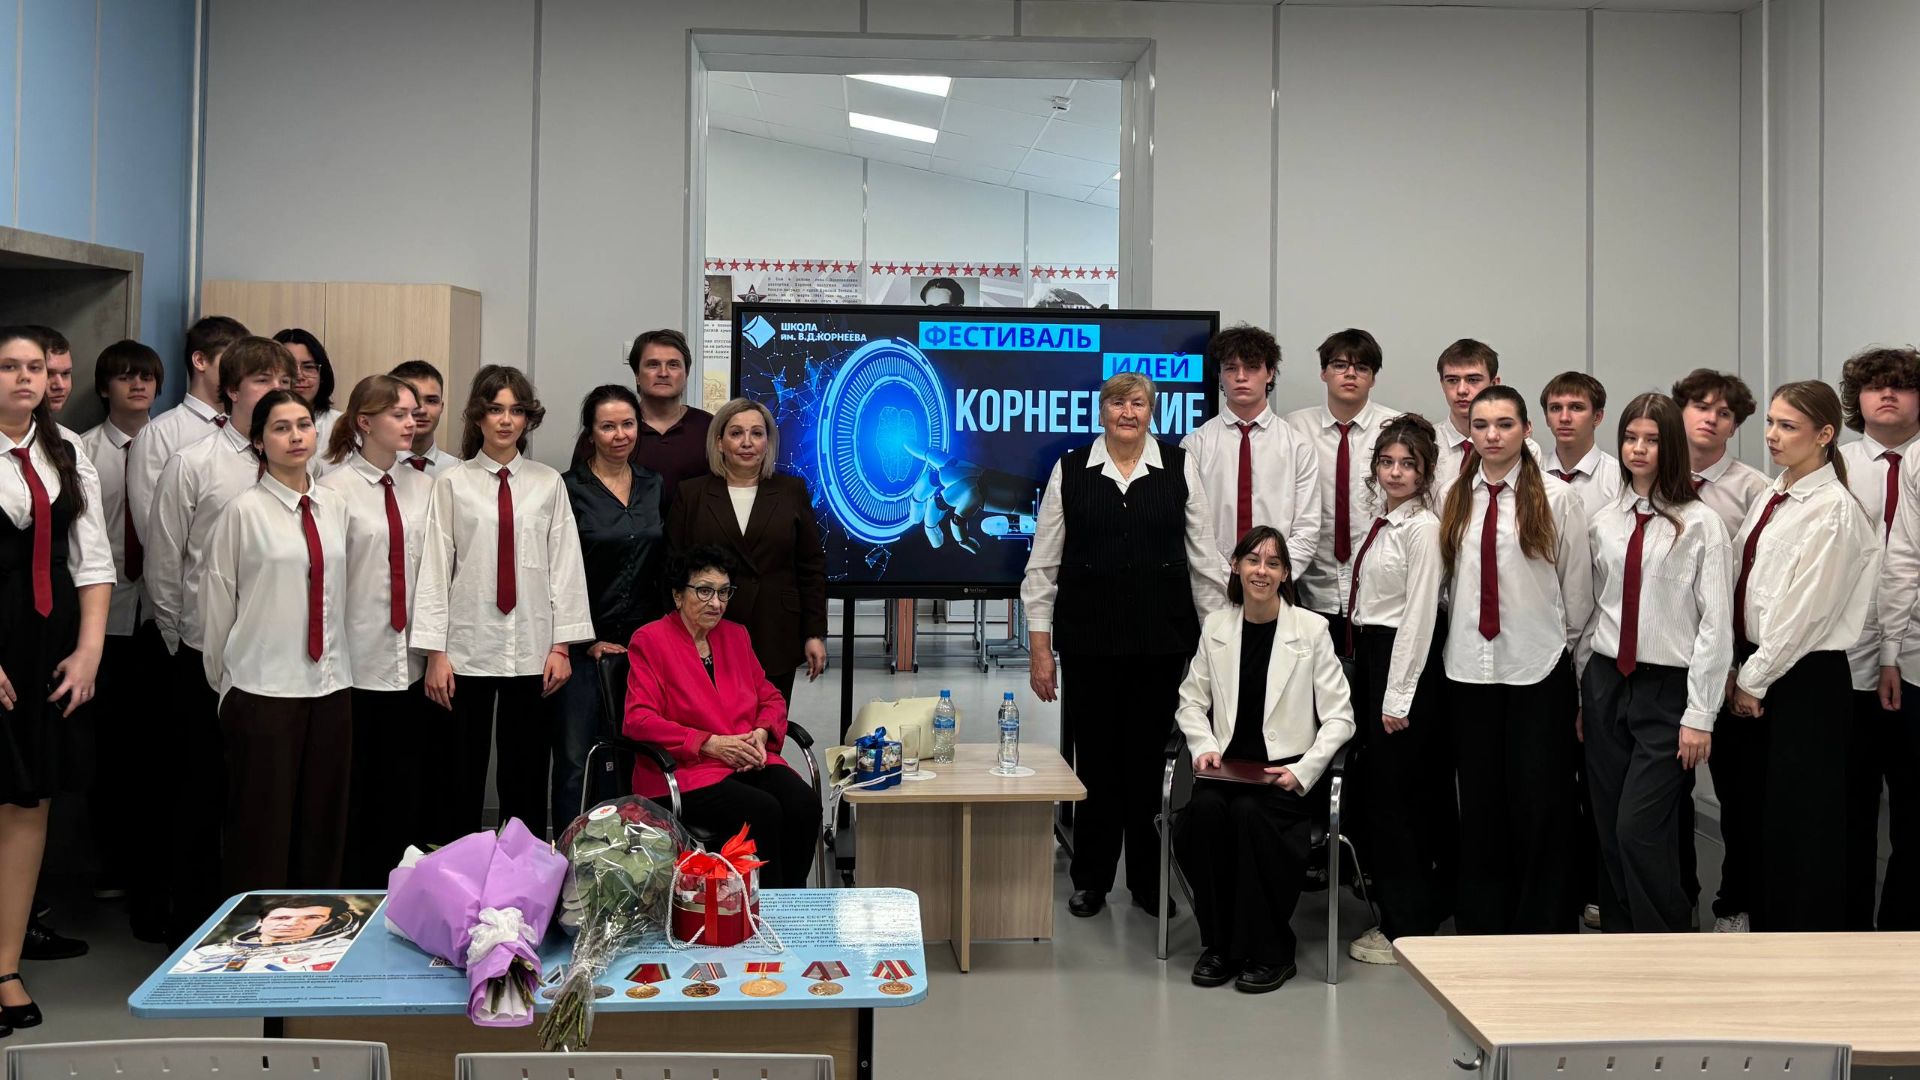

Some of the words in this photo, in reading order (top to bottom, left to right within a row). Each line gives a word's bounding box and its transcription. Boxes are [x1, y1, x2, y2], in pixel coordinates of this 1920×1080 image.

[780, 322, 818, 331] ШКОЛА
[780, 333, 796, 341] им.
[924, 325, 1092, 349] ФЕСТИВАЛЬ
[1112, 352, 1189, 379] ИДЕЙ
[955, 388, 1205, 435] КОРНЕЕИЕ
